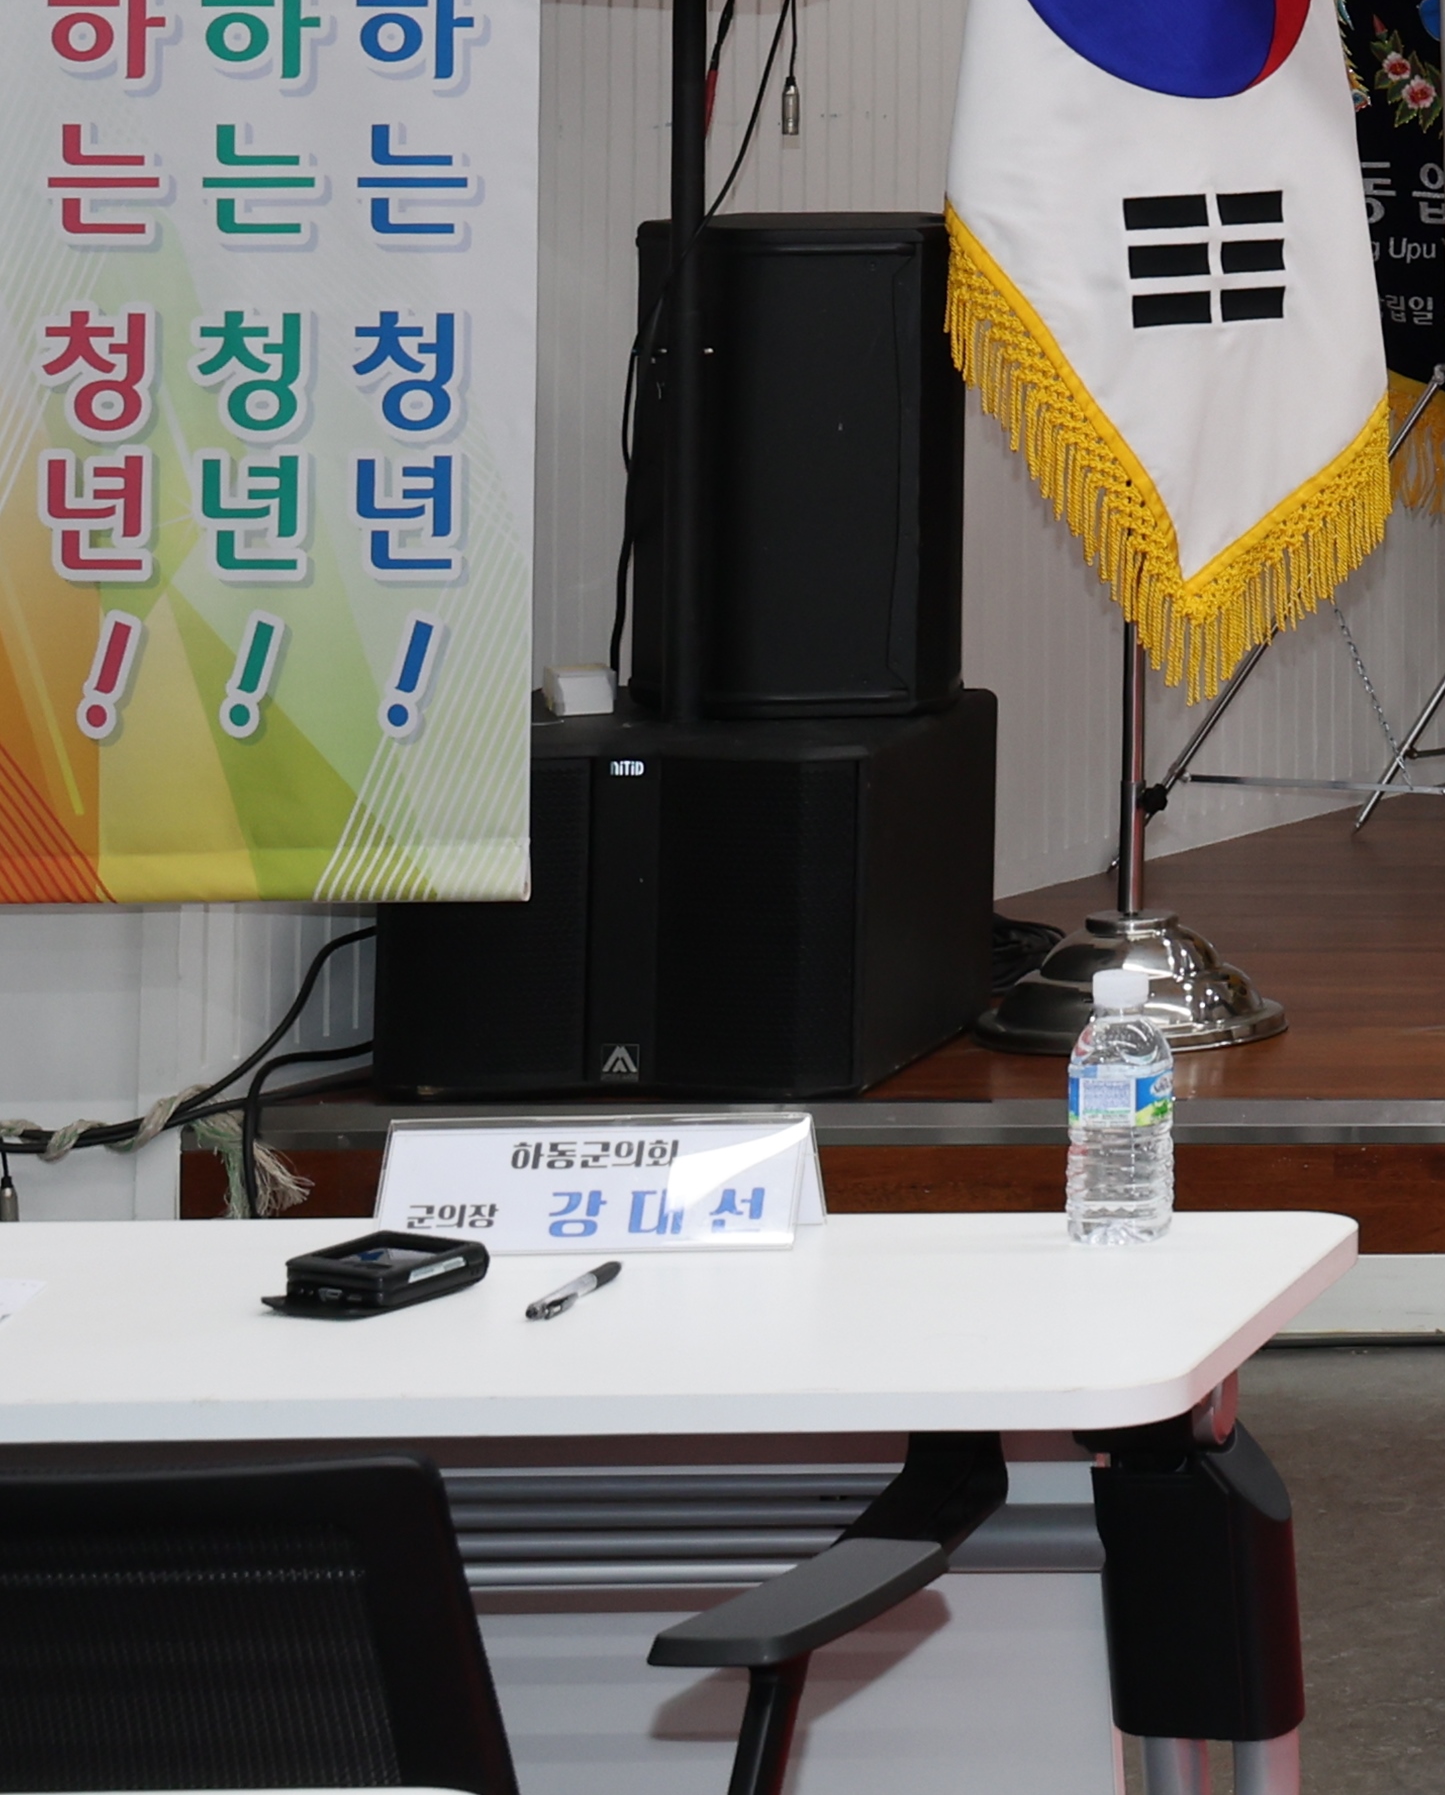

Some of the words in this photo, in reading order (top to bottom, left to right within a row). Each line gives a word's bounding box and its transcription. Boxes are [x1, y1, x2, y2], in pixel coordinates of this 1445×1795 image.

[1388, 236, 1437, 264] Upu
[510, 1139, 681, 1170] 하동군의회
[406, 1202, 500, 1230] 군의장
